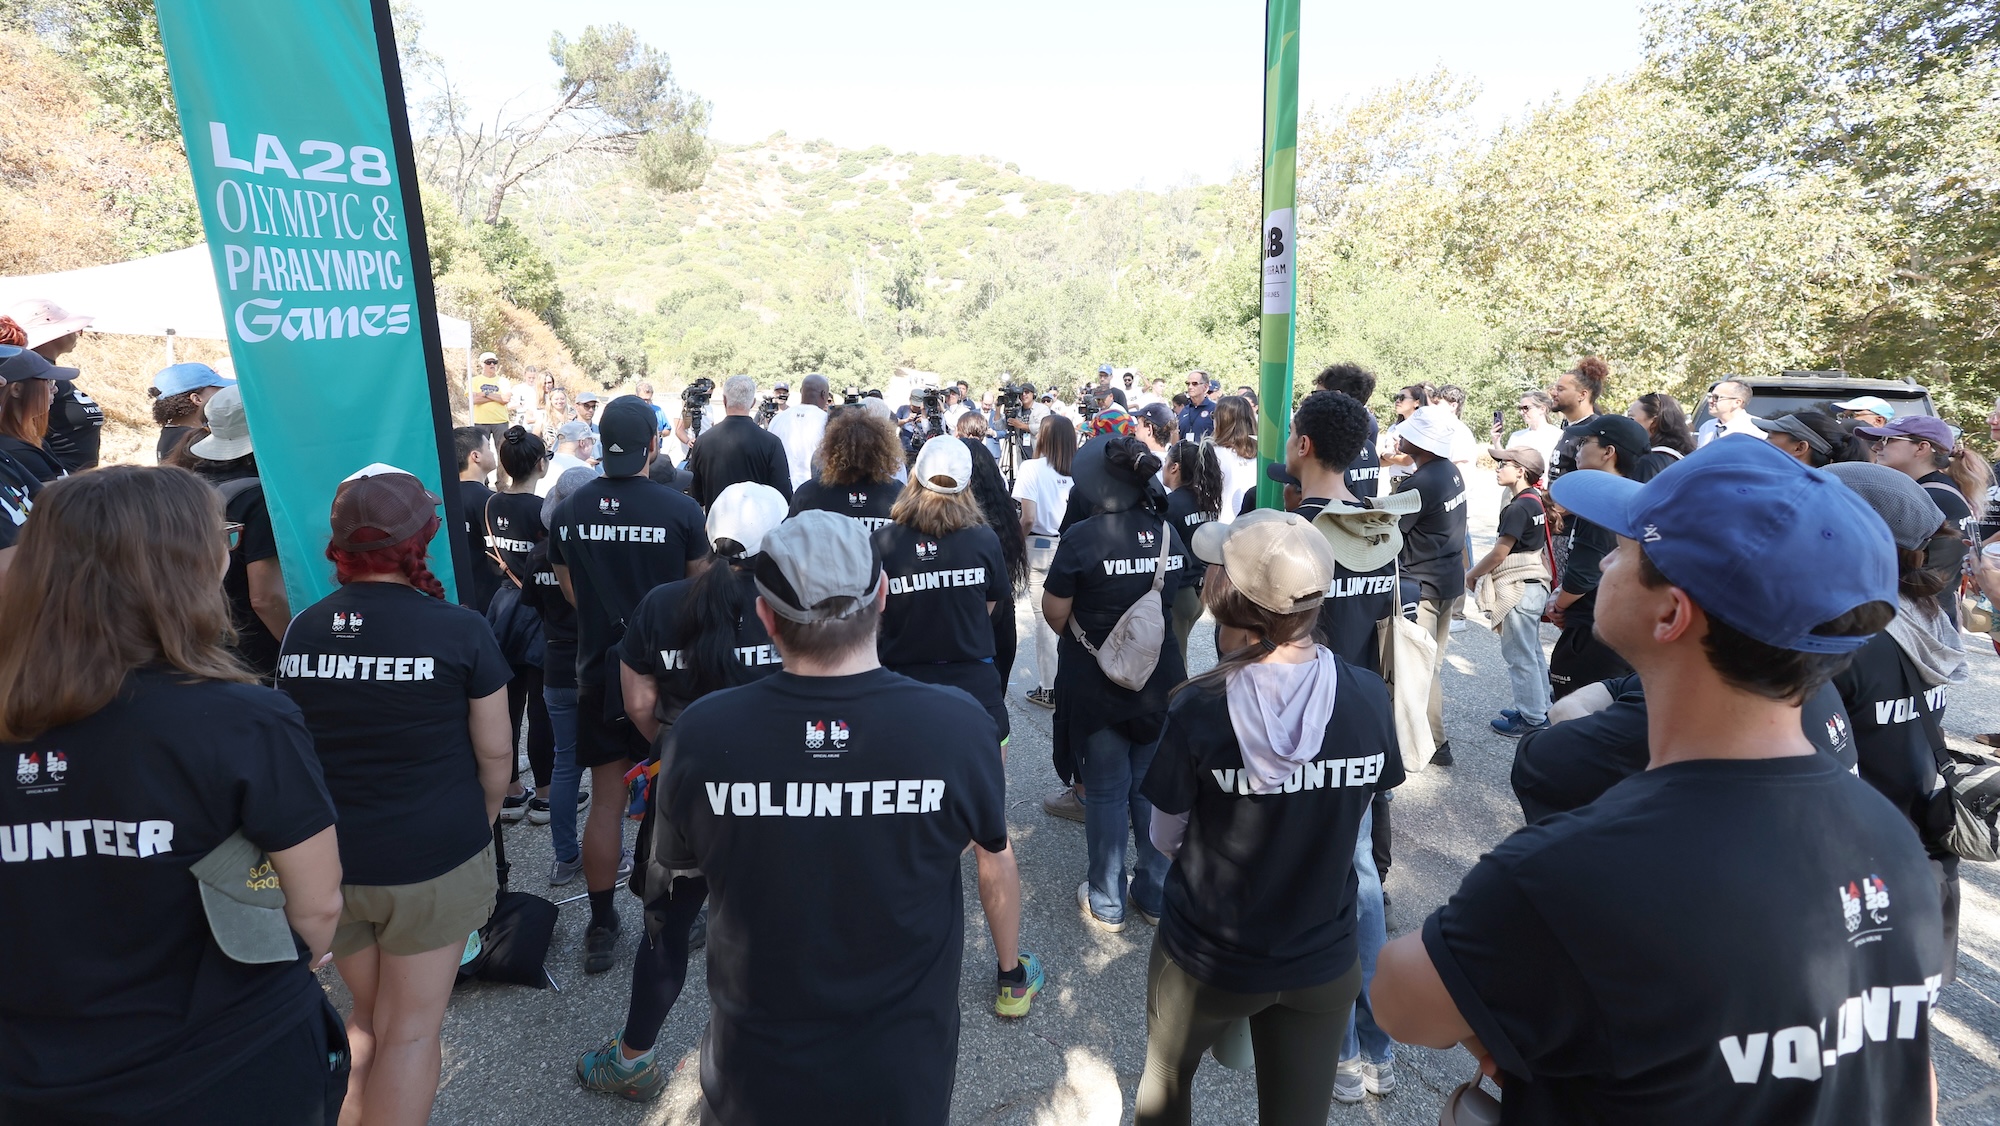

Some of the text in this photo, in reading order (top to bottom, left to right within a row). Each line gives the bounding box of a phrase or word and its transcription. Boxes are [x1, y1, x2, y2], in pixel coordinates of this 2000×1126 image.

[209, 121, 391, 186] LA28
[216, 180, 398, 241] OLYMPIC &
[224, 244, 403, 291] PARALYMPIC
[234, 298, 411, 343] Games
[559, 523, 666, 544] VLUNTEER
[888, 567, 985, 596] OLUNTEER
[705, 779, 946, 817] VOLUNTEER
[0, 819, 174, 863] UNTEER
